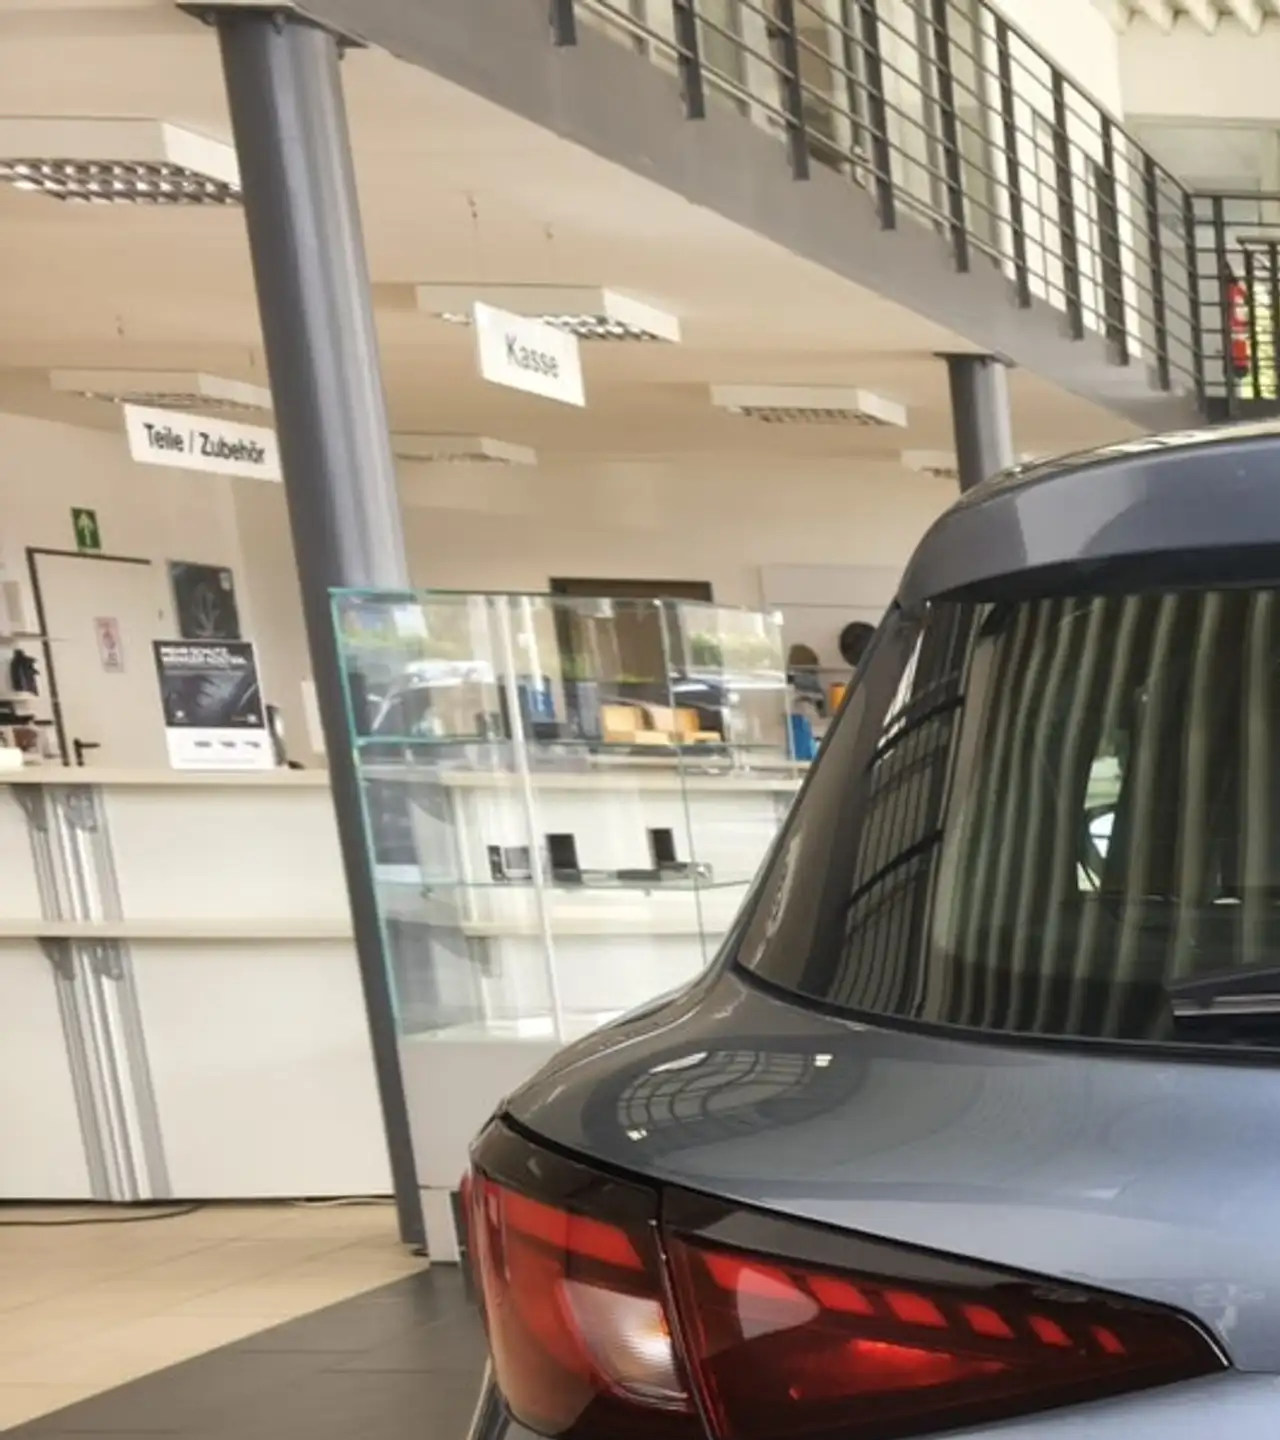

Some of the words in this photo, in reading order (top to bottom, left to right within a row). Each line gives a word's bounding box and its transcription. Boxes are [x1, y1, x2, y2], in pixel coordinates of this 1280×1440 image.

[504, 332, 559, 379] Kasse
[143, 423, 184, 452] Teile
[198, 432, 266, 465] Zubehör
